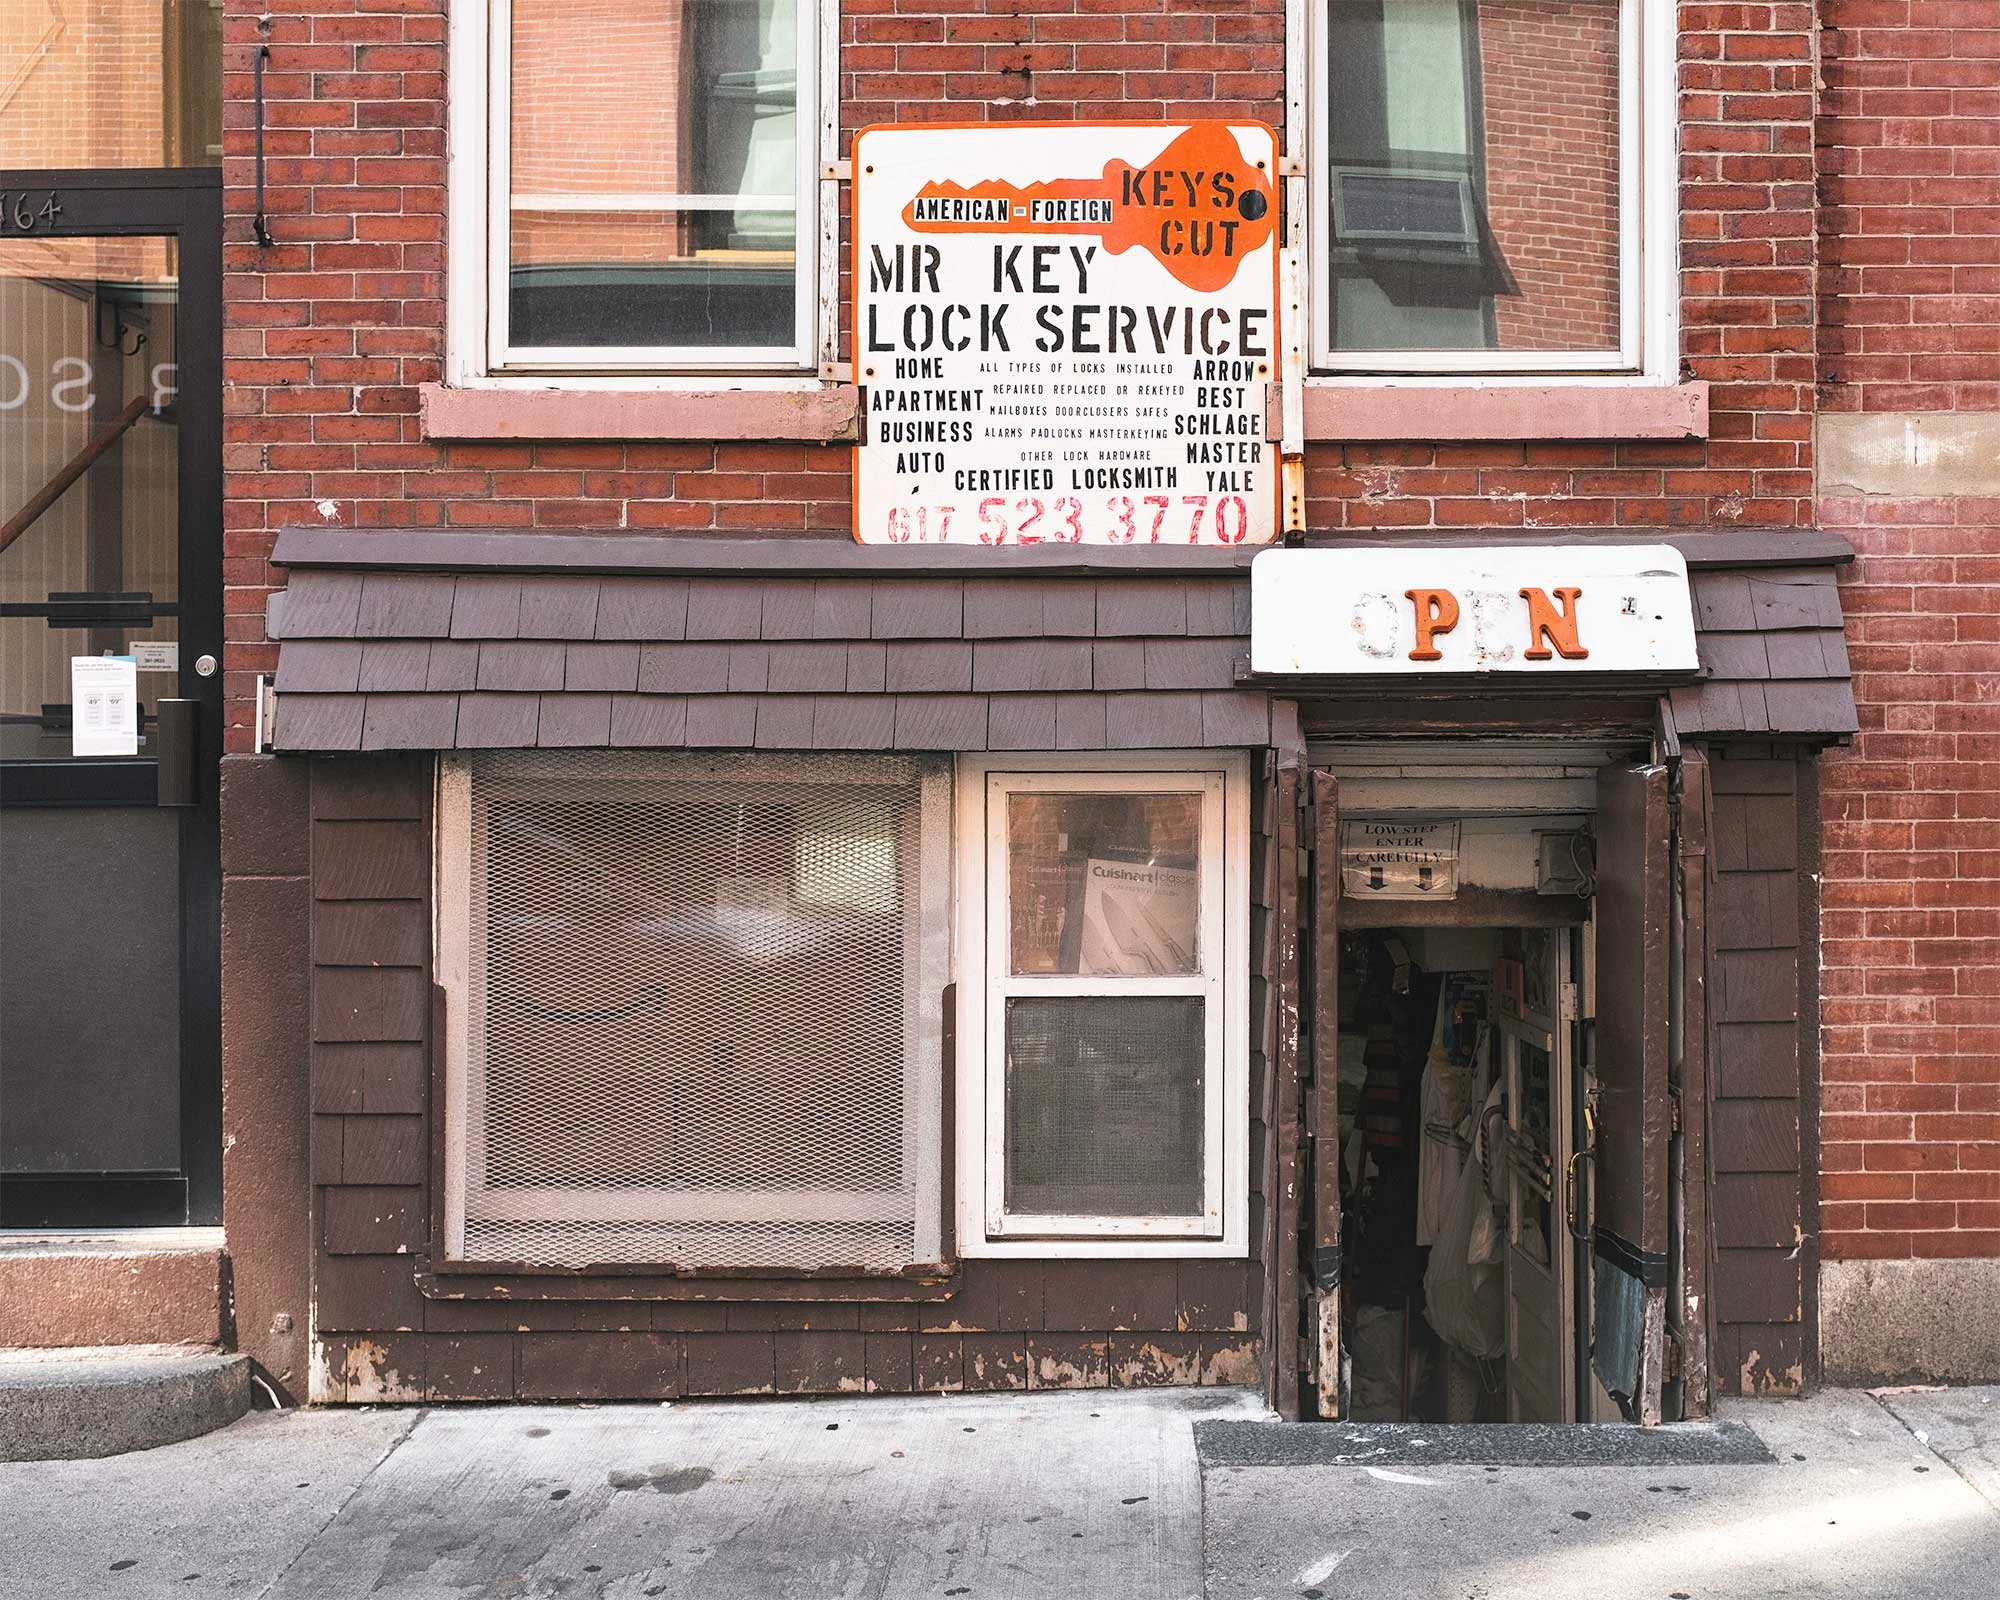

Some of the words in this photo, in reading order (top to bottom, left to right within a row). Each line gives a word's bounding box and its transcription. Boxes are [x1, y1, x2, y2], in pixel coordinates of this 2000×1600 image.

[1123, 170, 1235, 208] KEYS
[915, 199, 1008, 222] AMERICAN
[1031, 199, 1112, 222] FOREIGN
[1161, 220, 1239, 257] CUT
[870, 244, 941, 293] MR
[994, 245, 1097, 294] KEY
[868, 303, 1010, 353] LOCK
[1035, 304, 1268, 357] SERVICE
[895, 357, 944, 379] HOME
[979, 362, 999, 373] ALL
[1009, 362, 1041, 374] TYPES
[1050, 362, 1063, 373] OF
[1073, 363, 1106, 374] LOCKS
[1116, 363, 1174, 375] INSTALLED
[1192, 360, 1254, 382] ARROW
[872, 389, 984, 413] APARTMENT
[993, 384, 1044, 395] REPAIRED
[1053, 384, 1106, 395] REPLACED
[1116, 385, 1128, 396] OR
[1138, 385, 1185, 396] REKEYED
[1197, 386, 1245, 409] BEST
[989, 405, 1048, 416] MAILBOXES
[1055, 406, 1129, 418] DOORCLOSERS
[1135, 407, 1169, 418] SAFES
[880, 421, 973, 444] BUSINESS
[984, 427, 1023, 439] ALARMS
[1030, 428, 1083, 439] PADLOCKS
[1089, 428, 1168, 440] MASTERKEYING
[1174, 413, 1260, 436] SCHLAGE
[896, 451, 945, 474] AUTO
[1020, 451, 1053, 462] OTHER
[1063, 450, 1089, 461] LOCK
[1099, 450, 1151, 461] HARDWARE
[1186, 442, 1261, 464] MASTER
[954, 468, 1054, 491] CERTIFIED
[1071, 466, 1178, 490] LOCKSMITH
[1206, 470, 1254, 492] YALE
[886, 505, 956, 544] 617
[978, 496, 1084, 545] 523
[1105, 495, 1247, 545] 3770
[1364, 824, 1397, 835] LOW
[1402, 825, 1438, 835] STEP
[1376, 837, 1424, 847] ENTER
[1356, 851, 1443, 864] CAREFULLY
[1092, 866, 1153, 884] Cuisinart
